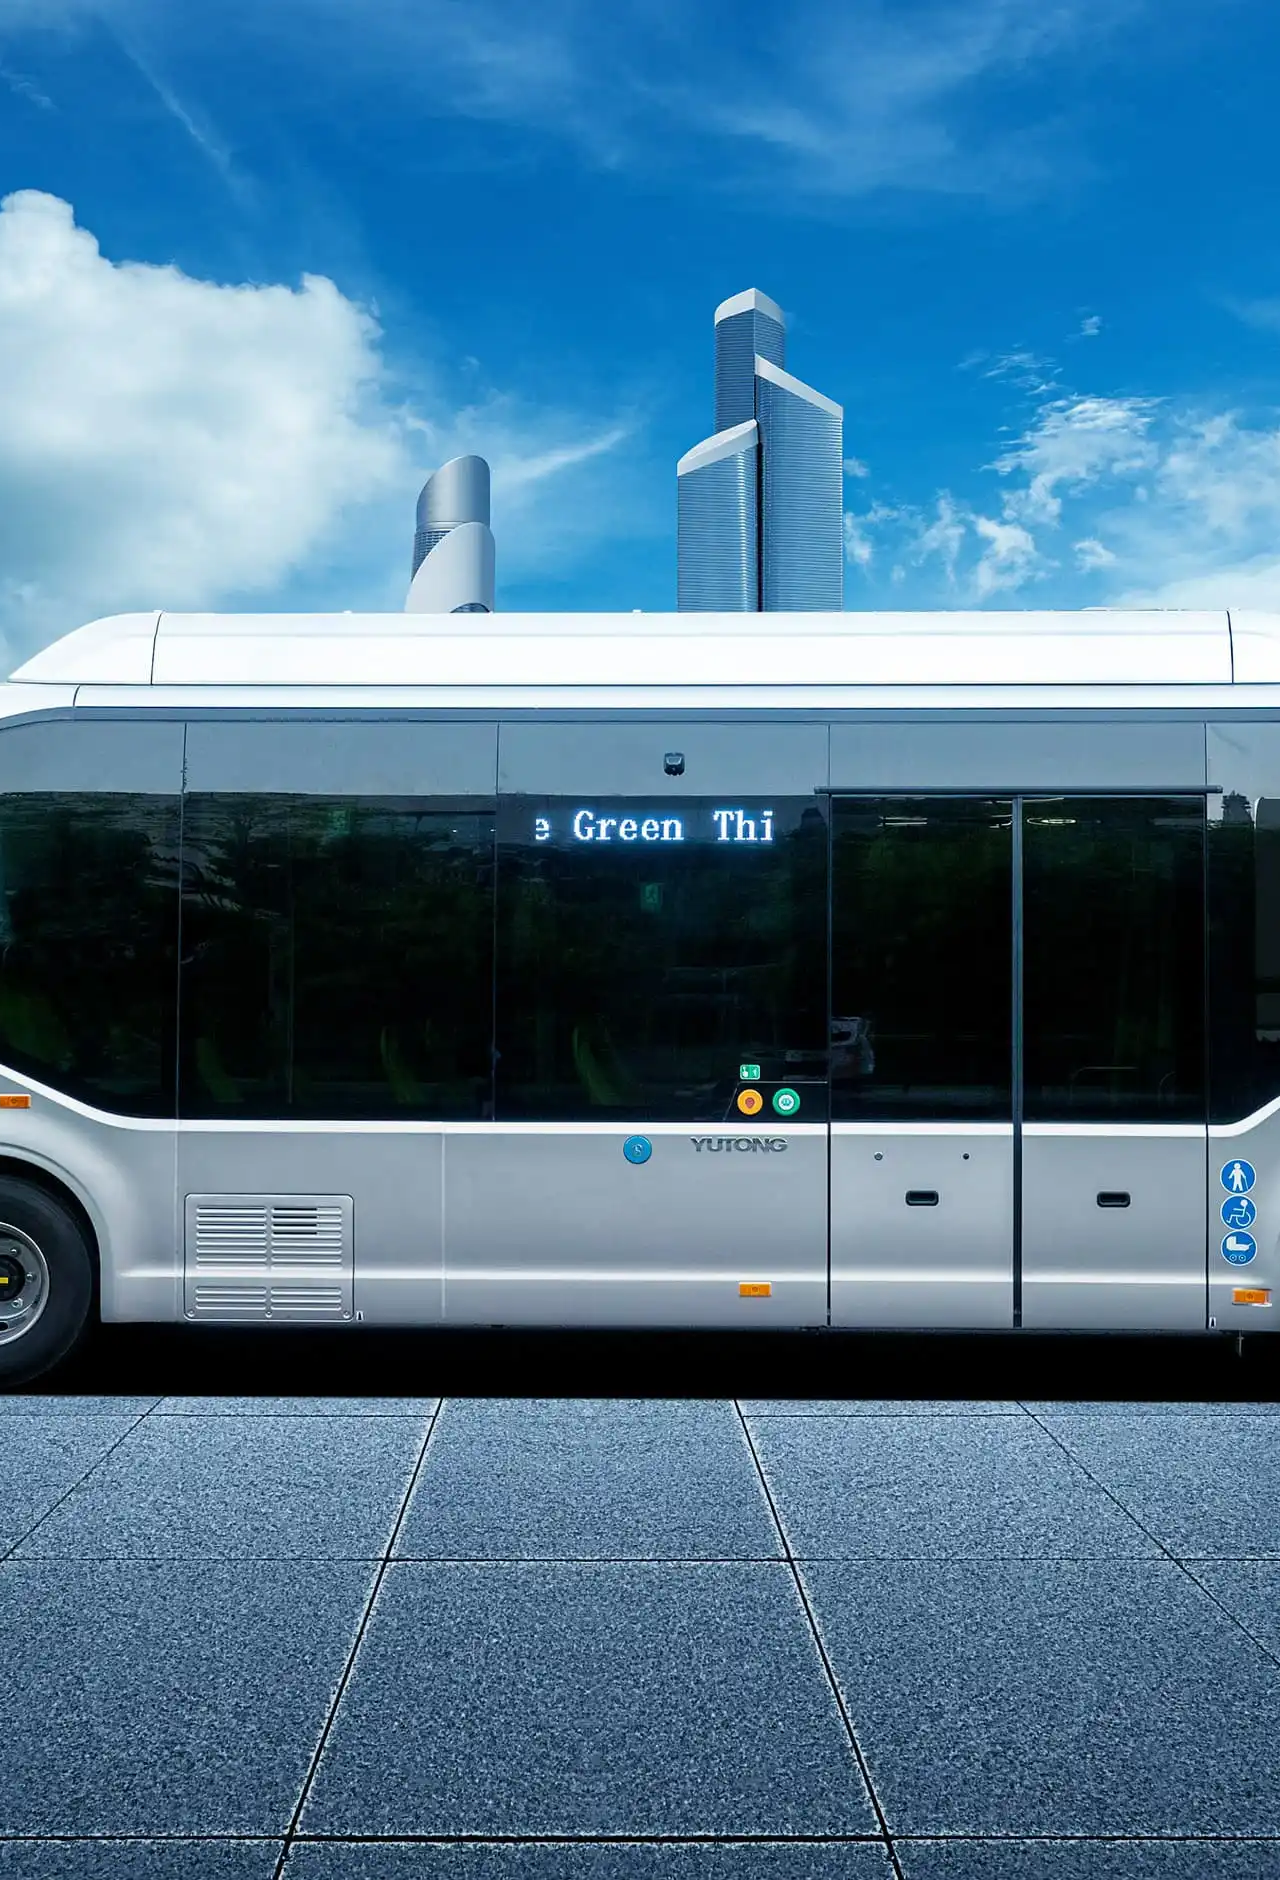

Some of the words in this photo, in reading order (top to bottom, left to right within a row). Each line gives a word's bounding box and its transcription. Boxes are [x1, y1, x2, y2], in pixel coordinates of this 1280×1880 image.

[573, 809, 684, 841] Green
[713, 809, 773, 841] Thi
[689, 1137, 789, 1153] YUTONG
